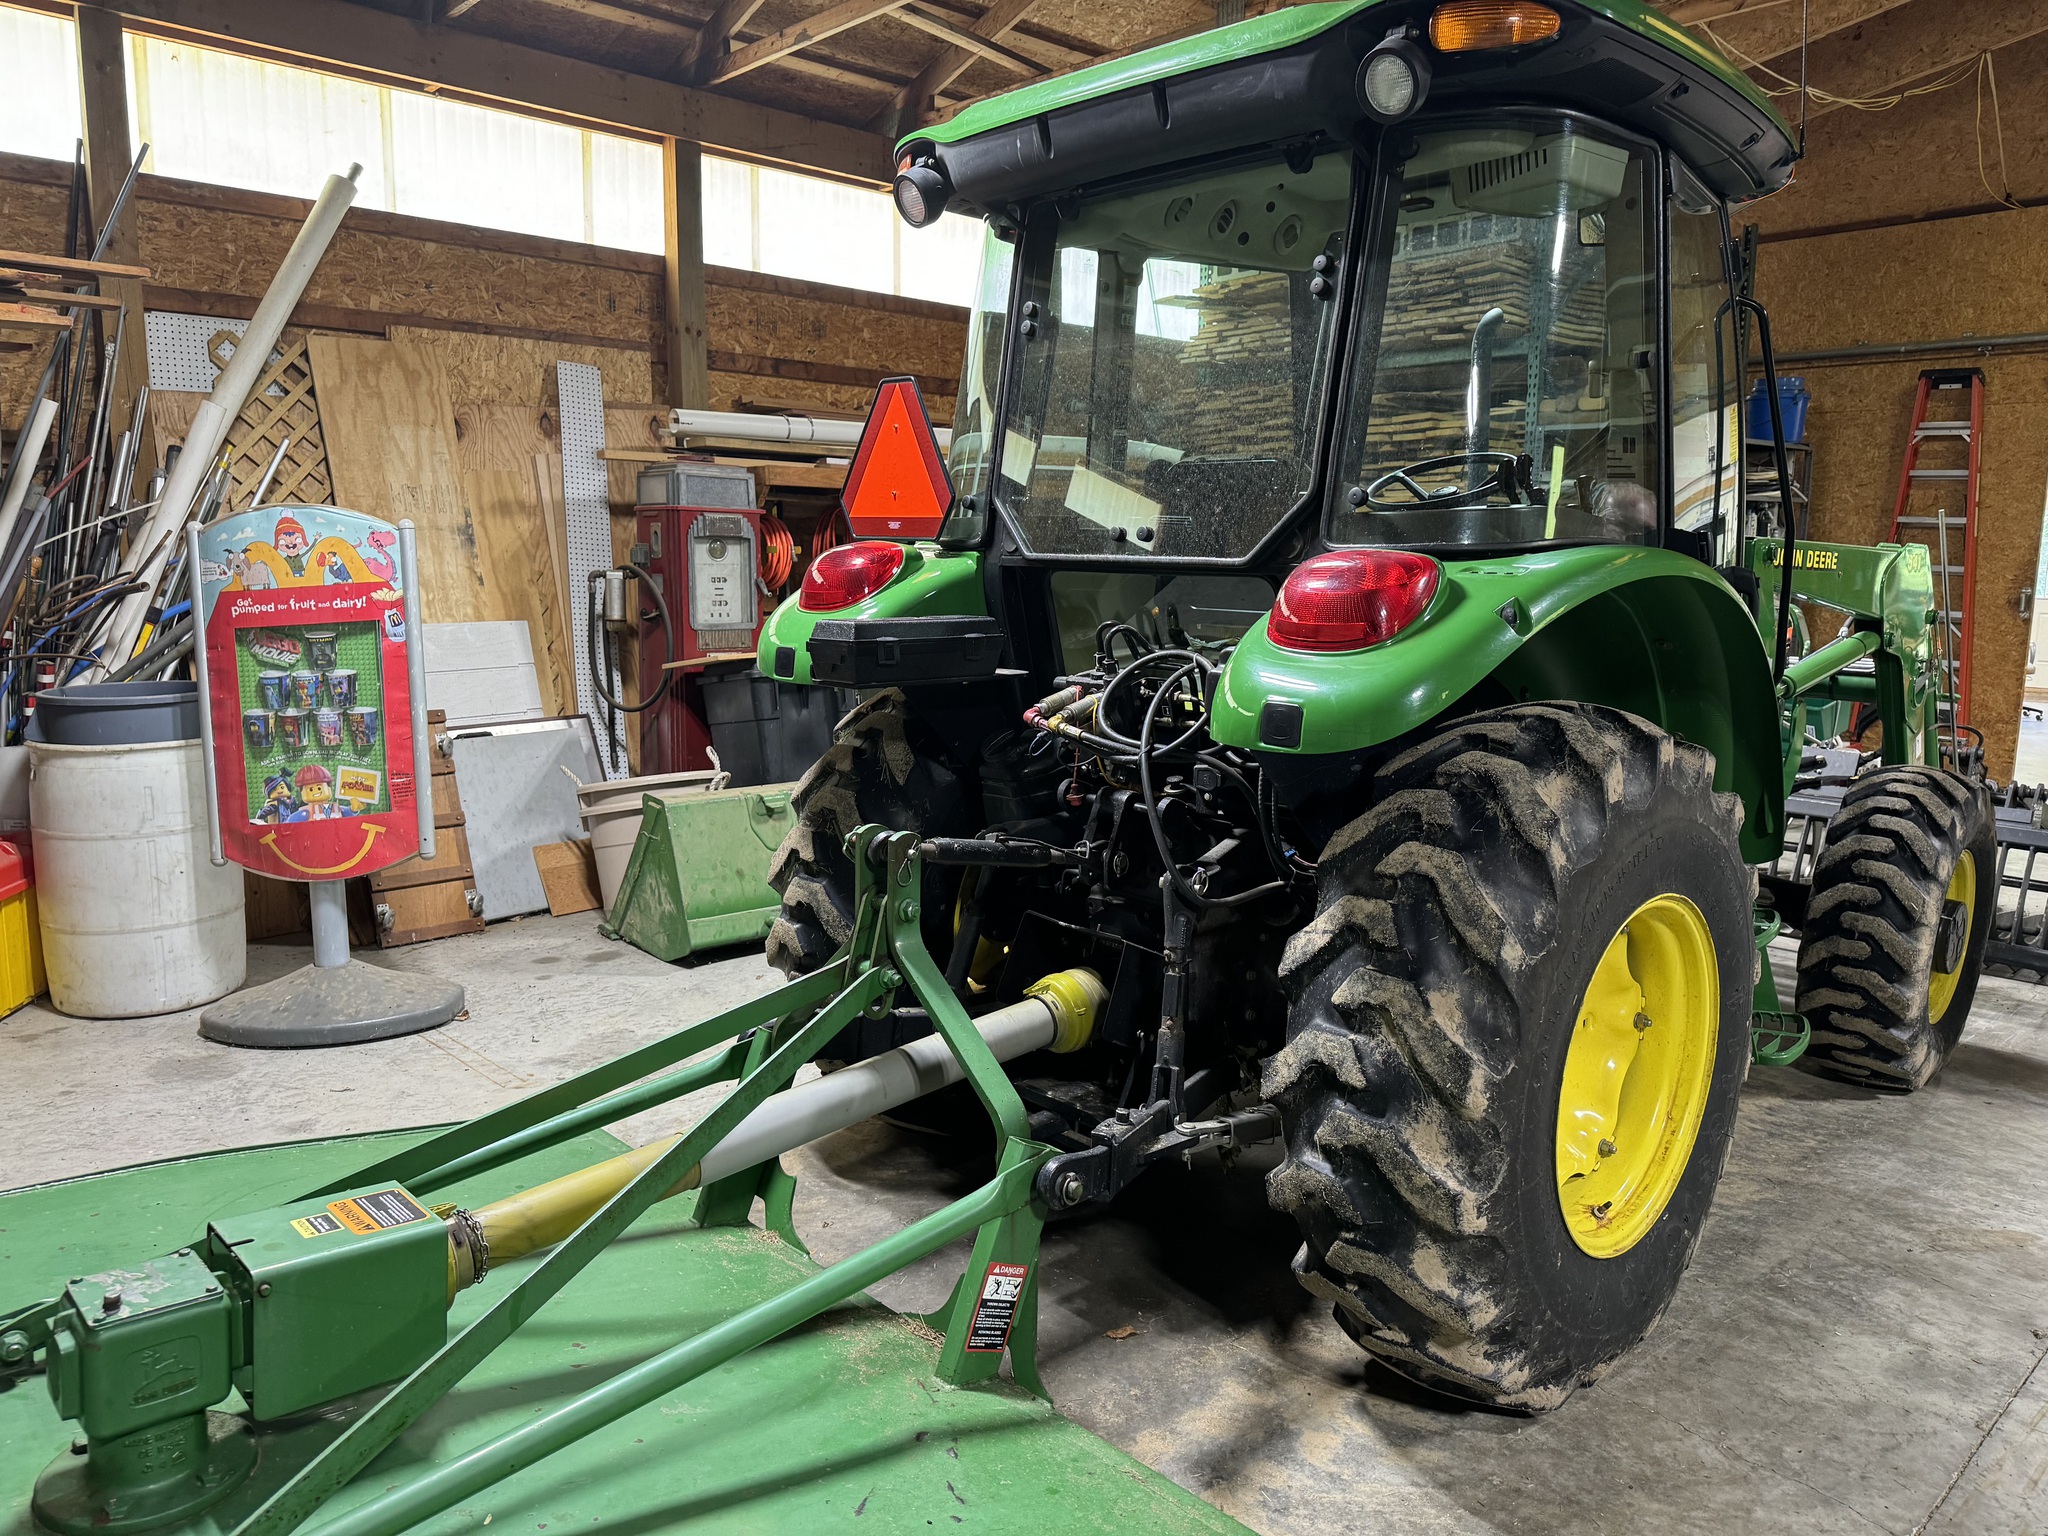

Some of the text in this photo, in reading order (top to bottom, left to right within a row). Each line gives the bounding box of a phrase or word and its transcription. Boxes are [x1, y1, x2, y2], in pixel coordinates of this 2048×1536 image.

[1806, 550, 1839, 570] DEERE
[231, 602, 275, 618] pumped
[277, 603, 288, 611] for
[289, 598, 317, 611] fruit
[332, 596, 367, 609] dairy!
[237, 598, 253, 607] Get
[251, 643, 300, 663] MOVIE
[334, 1201, 367, 1228] WARNING
[1000, 1266, 1025, 1275] DANGER
